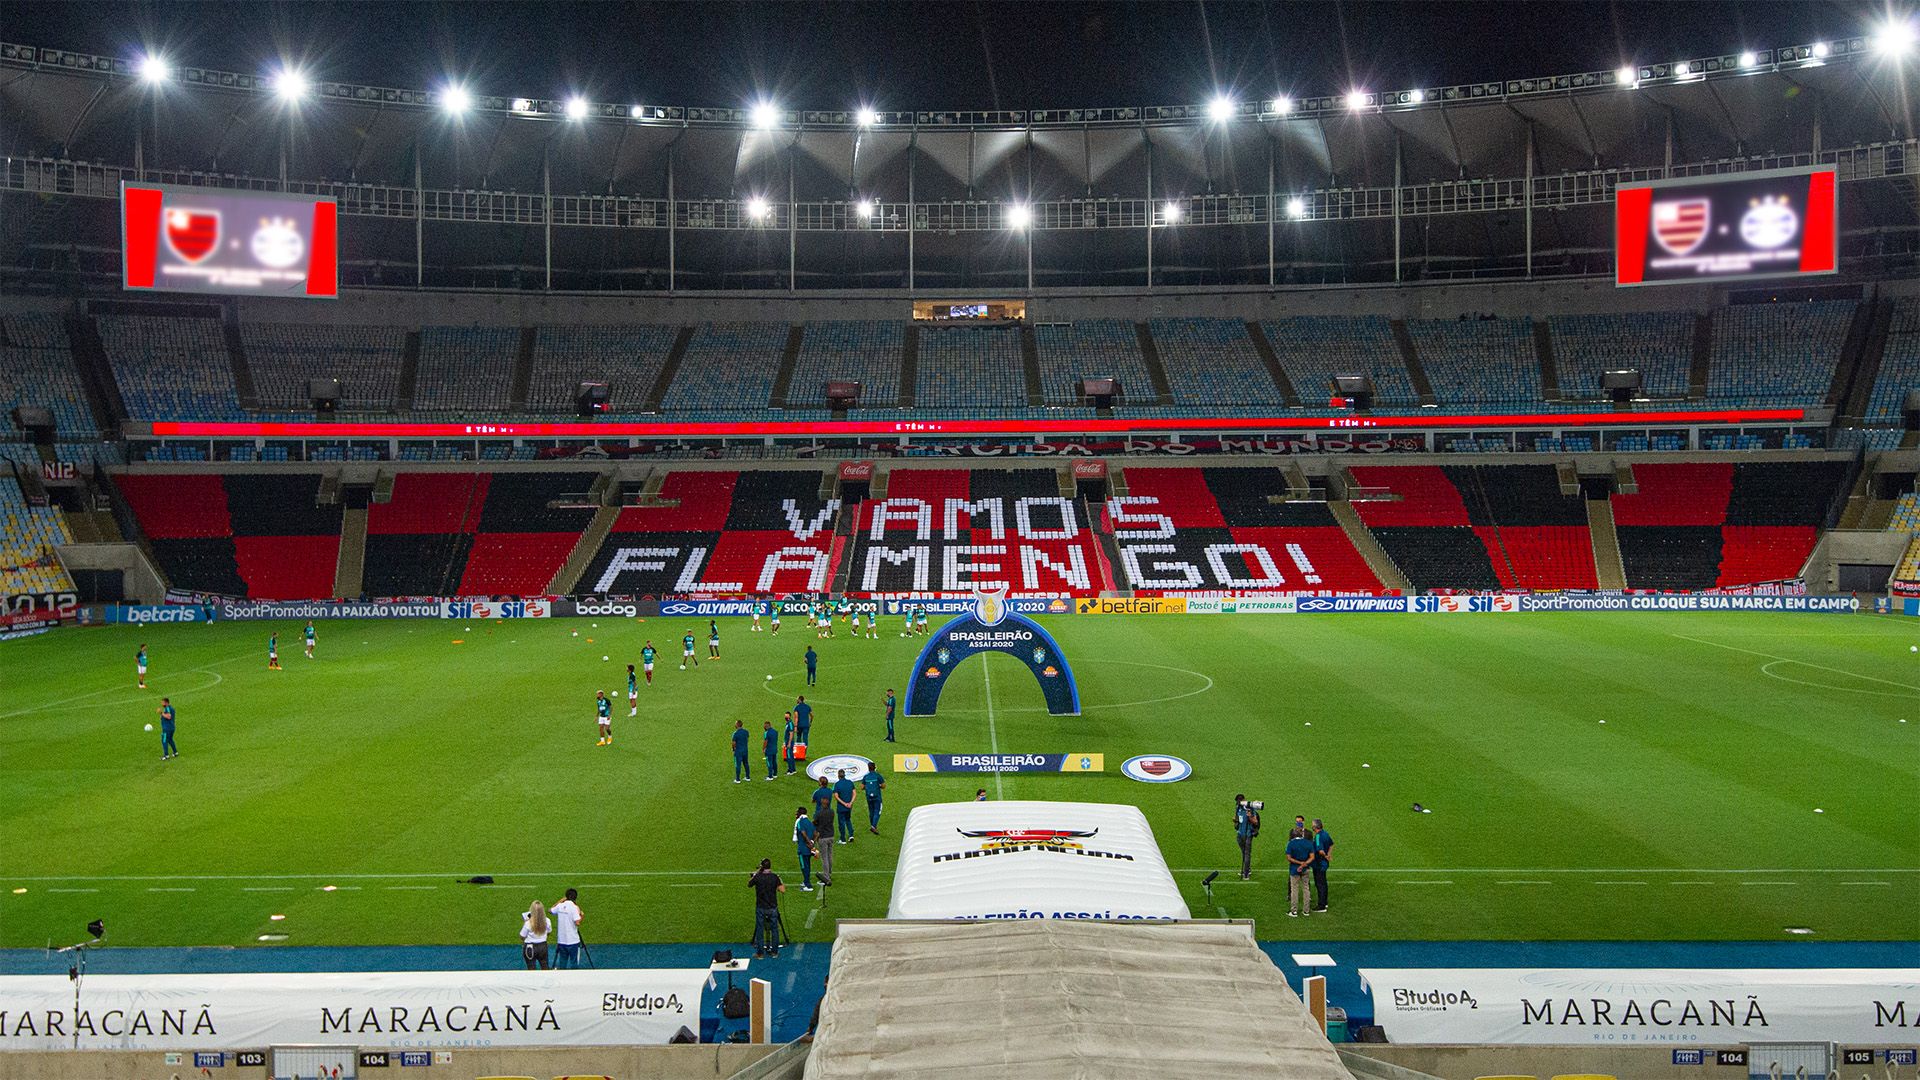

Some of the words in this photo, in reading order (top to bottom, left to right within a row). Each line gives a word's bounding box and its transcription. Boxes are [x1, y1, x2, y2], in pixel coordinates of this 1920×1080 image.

[781, 497, 1177, 541] VAMOS
[224, 604, 328, 620] SportPromotion
[331, 602, 342, 617] A
[342, 601, 388, 617] PAIXÃO
[392, 602, 440, 617] VOLTOU
[447, 602, 472, 619] Sil
[500, 602, 525, 619] Sil
[576, 602, 637, 617] bodog
[1017, 602, 1046, 613] 2020
[1188, 600, 1213, 611] Posto
[1239, 601, 1294, 609] PETROBRAS
[1335, 598, 1406, 611] OLYMPIKUS
[1414, 596, 1439, 613] Sil
[1468, 596, 1493, 613] Sil
[1522, 596, 1628, 612] SportPromotion
[1631, 597, 1697, 610] COLOQUE
[1700, 597, 1729, 609] SUA
[1732, 597, 1782, 609] MARCA
[1786, 598, 1806, 609] EM
[1808, 598, 1860, 610] CAMPO
[127, 606, 196, 623] betcris
[949, 629, 1033, 641] BRASILEIRÃO
[969, 640, 991, 648] ASSAÍ
[951, 754, 1046, 766] BRASILEIRÃO
[320, 999, 561, 1034] MARACANÃ
[1521, 995, 1769, 1028] MARACANÃ
[0, 1004, 217, 1037] ARACANÃ
[390, 1039, 411, 1047] RIO
[418, 1039, 431, 1047] DE
[439, 1039, 492, 1047] JANEIRO
[1593, 1033, 1615, 1041] RIO
[1622, 1033, 1637, 1041] DE
[1644, 1033, 1698, 1041] JANEIRO
[239, 1054, 262, 1065] 103
[362, 1055, 386, 1065] 104
[1720, 1053, 1743, 1064] 104
[1847, 1052, 1870, 1063] 105
